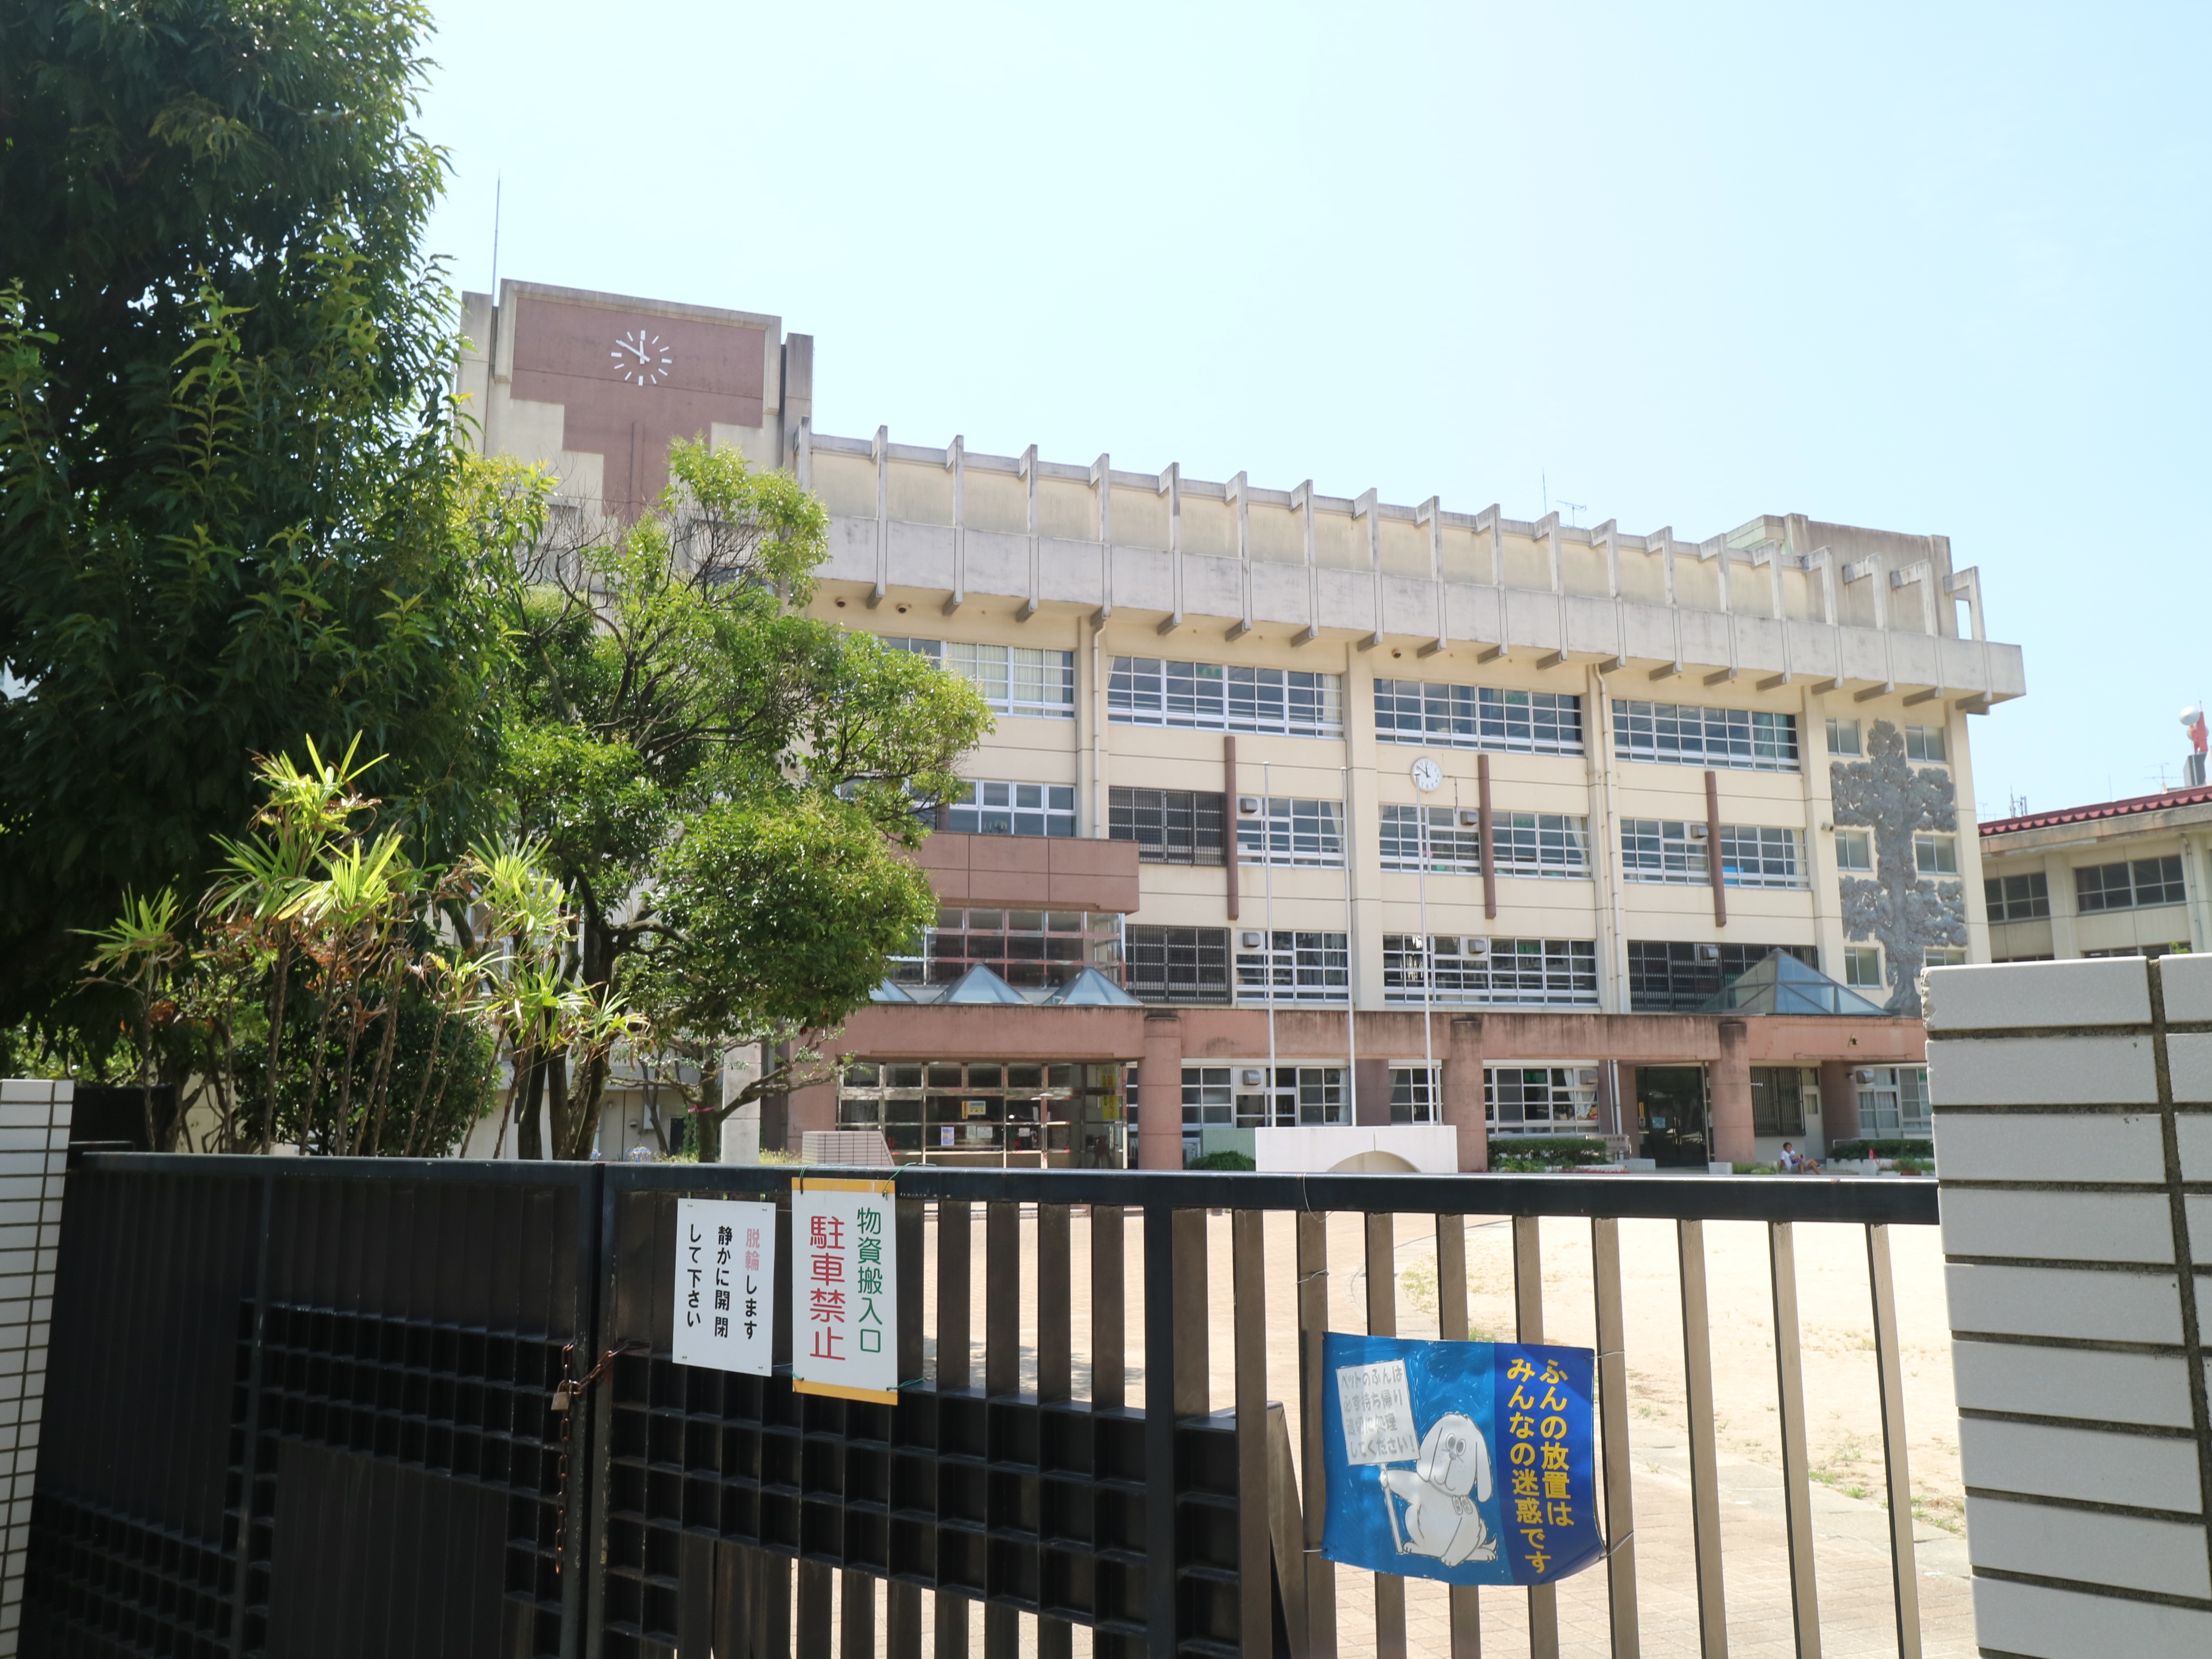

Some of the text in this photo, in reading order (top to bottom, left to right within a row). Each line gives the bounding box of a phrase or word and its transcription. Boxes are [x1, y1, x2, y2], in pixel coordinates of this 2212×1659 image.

[687, 1224, 702, 1328] して下さい
[715, 1225, 733, 1338] 静かに開閉
[744, 1228, 760, 1340] 脱輪します
[809, 1215, 846, 1361] 駐車禁止
[857, 1207, 882, 1353] 物資搬入口
[1341, 1365, 1403, 1389] ペットのふんは
[1507, 1358, 1551, 1574] みんなの迷惑です
[1539, 1359, 1574, 1527] ふんの放置は
